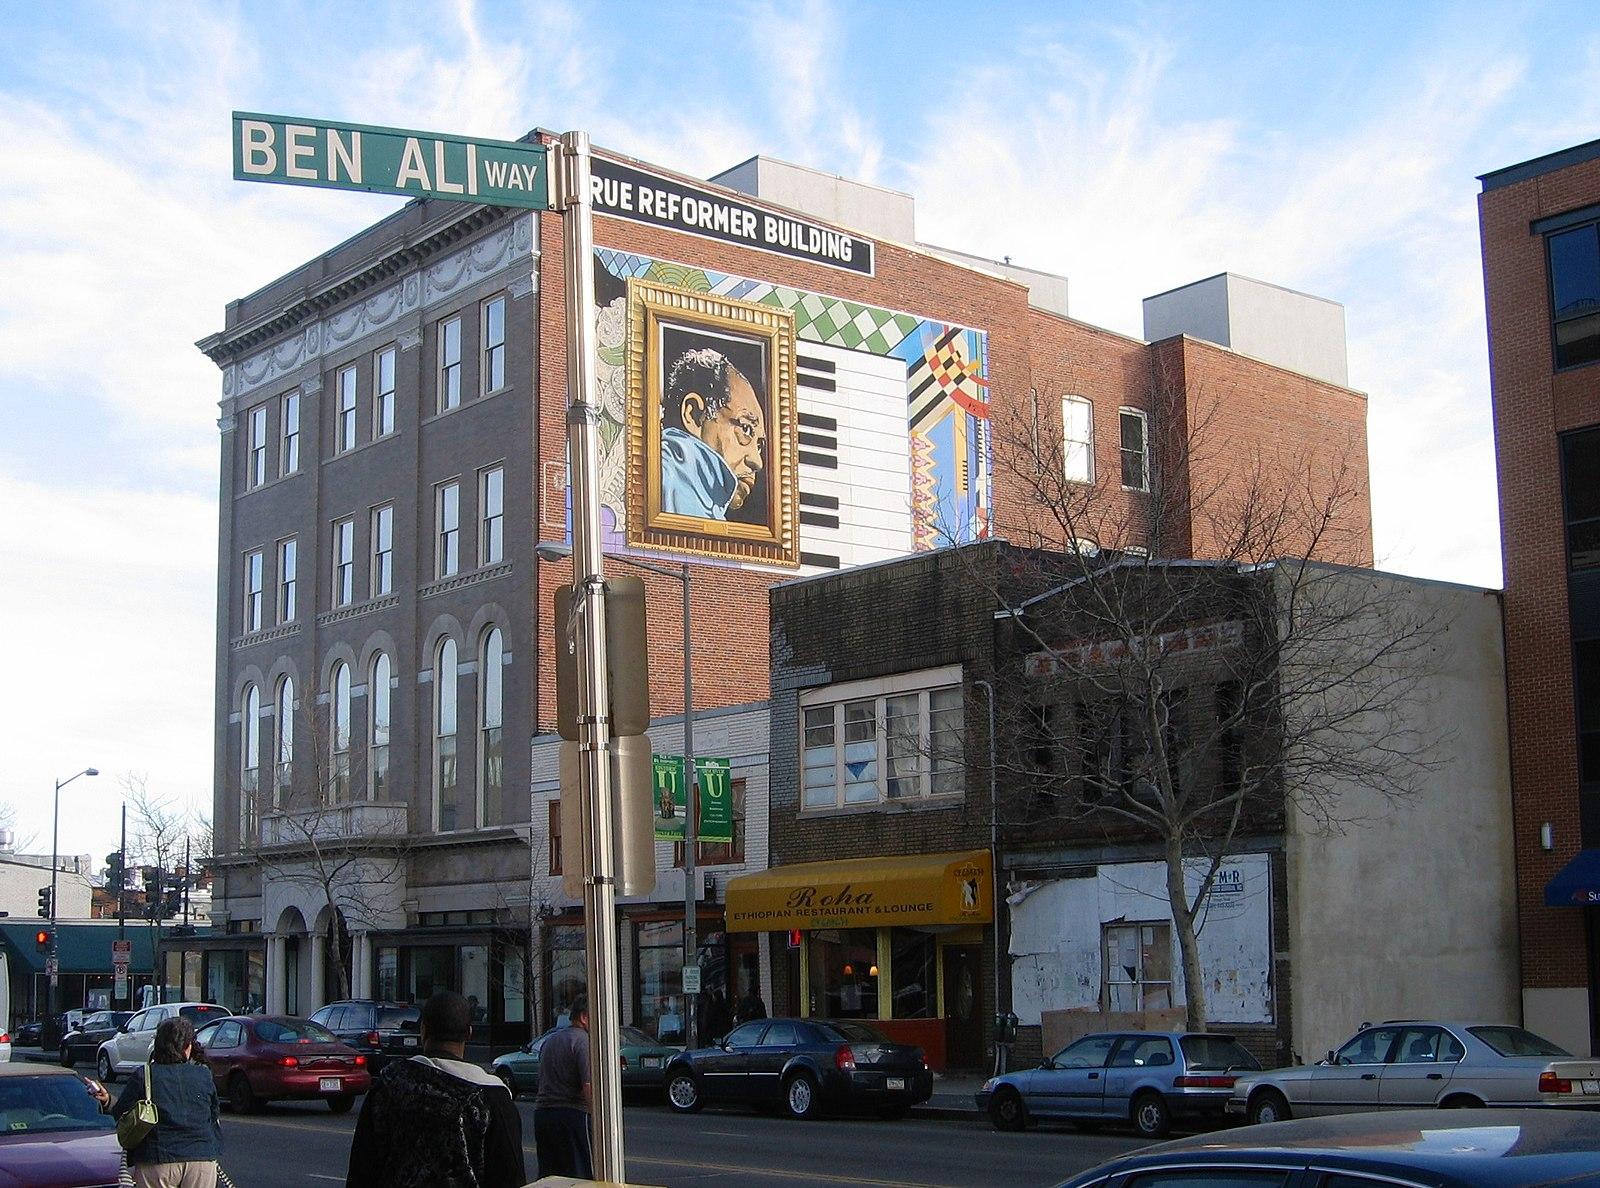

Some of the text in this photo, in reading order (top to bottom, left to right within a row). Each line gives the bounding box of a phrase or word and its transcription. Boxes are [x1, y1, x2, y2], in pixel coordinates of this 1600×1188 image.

[241, 119, 538, 195] BEN ALI WAY
[590, 174, 853, 262] RUE REFORMER BUILDING
[704, 773, 724, 798] U
[786, 884, 874, 908] Roha
[734, 902, 934, 921] ETHIOPIAN RESTAURANT & LOUNGE
